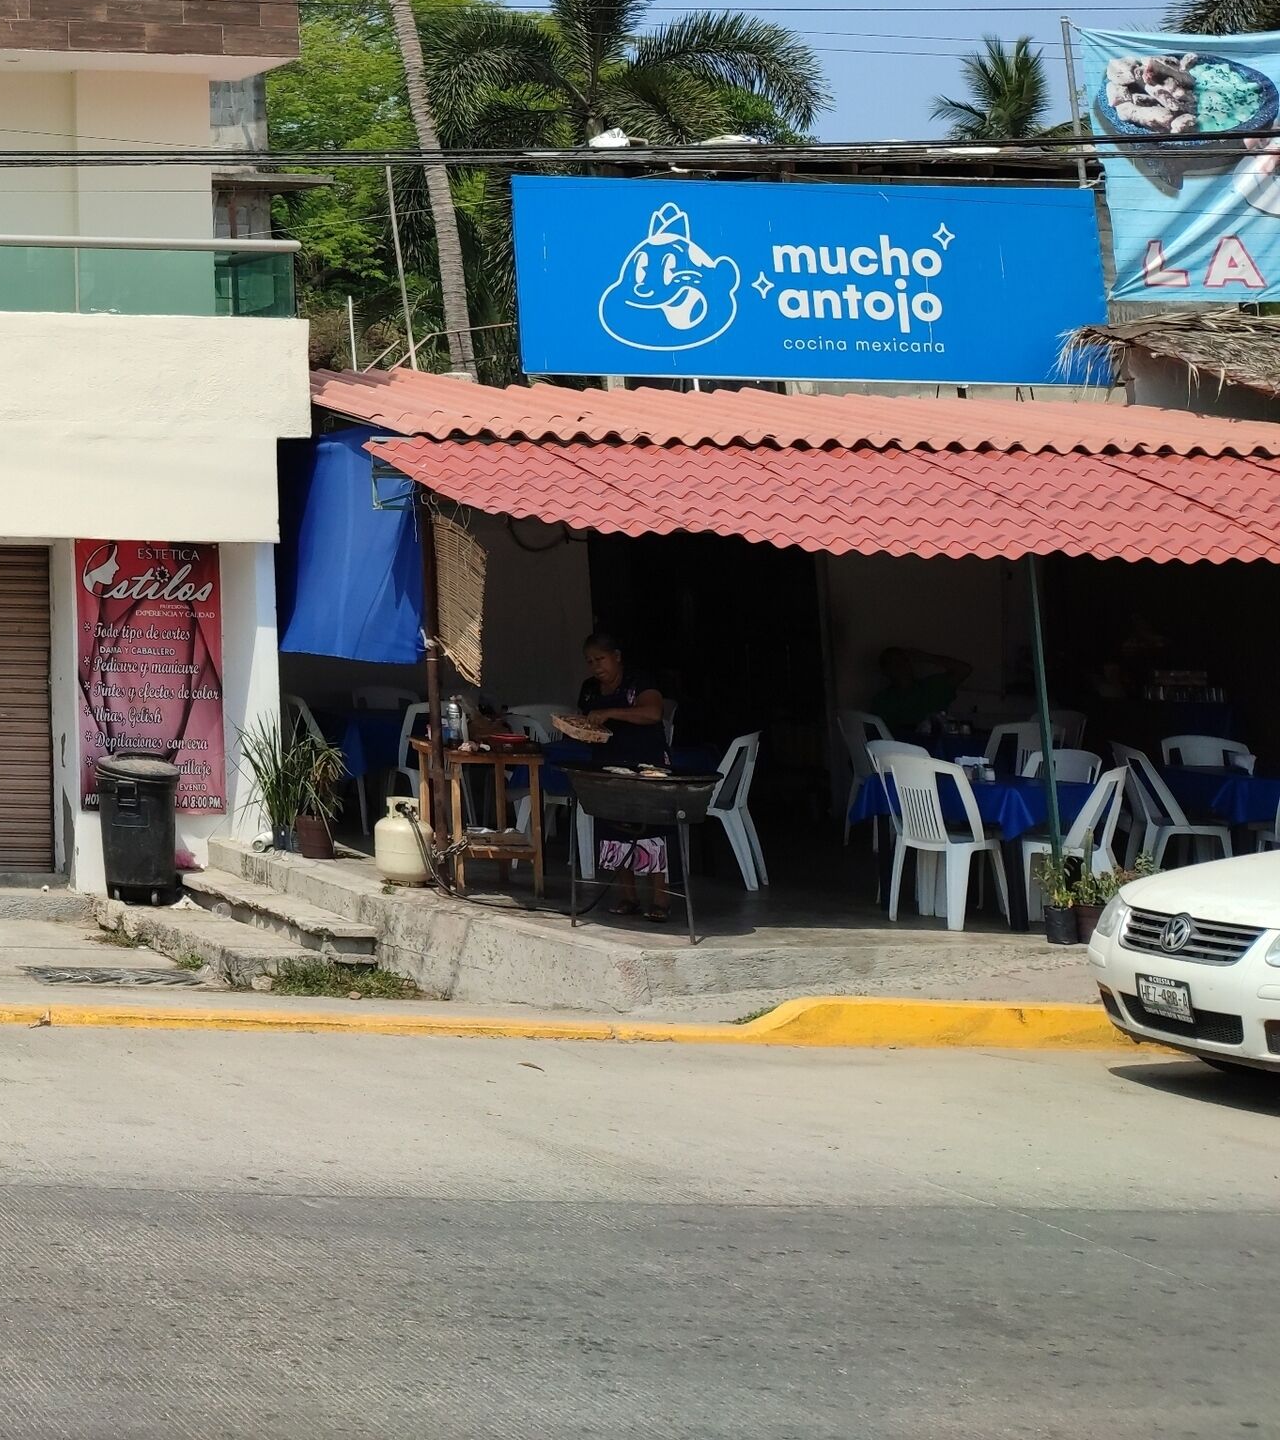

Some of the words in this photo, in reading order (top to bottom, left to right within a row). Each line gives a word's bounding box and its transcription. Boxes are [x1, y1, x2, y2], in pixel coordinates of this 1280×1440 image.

[772, 234, 942, 277] mucho
[778, 278, 943, 333] antojo
[783, 336, 847, 351] cocina
[855, 338, 945, 353] mexicana
[138, 548, 200, 561] ESTETICA
[135, 610, 177, 618] EXPERIENCIA
[185, 611, 216, 619] CALIDAD
[93, 622, 119, 638] Todo
[122, 625, 143, 643] tipo
[146, 624, 158, 639] de
[161, 627, 190, 641] cortes
[99, 646, 122, 654] DAMA
[131, 647, 176, 656] CABALLERO
[93, 657, 138, 673] Pedicure
[140, 662, 149, 677] y
[151, 661, 199, 674] manicure
[93, 681, 125, 696] Tintes
[129, 687, 136, 703] y
[138, 683, 174, 702] efectos
[177, 685, 190, 699] de
[191, 685, 219, 700] color
[95, 731, 163, 752] Depilaciones
[166, 739, 185, 750] con
[188, 739, 208, 750] cera
[179, 783, 207, 792] EVENTO
[190, 796, 207, 808] 8:00
[208, 796, 224, 809] PM.
